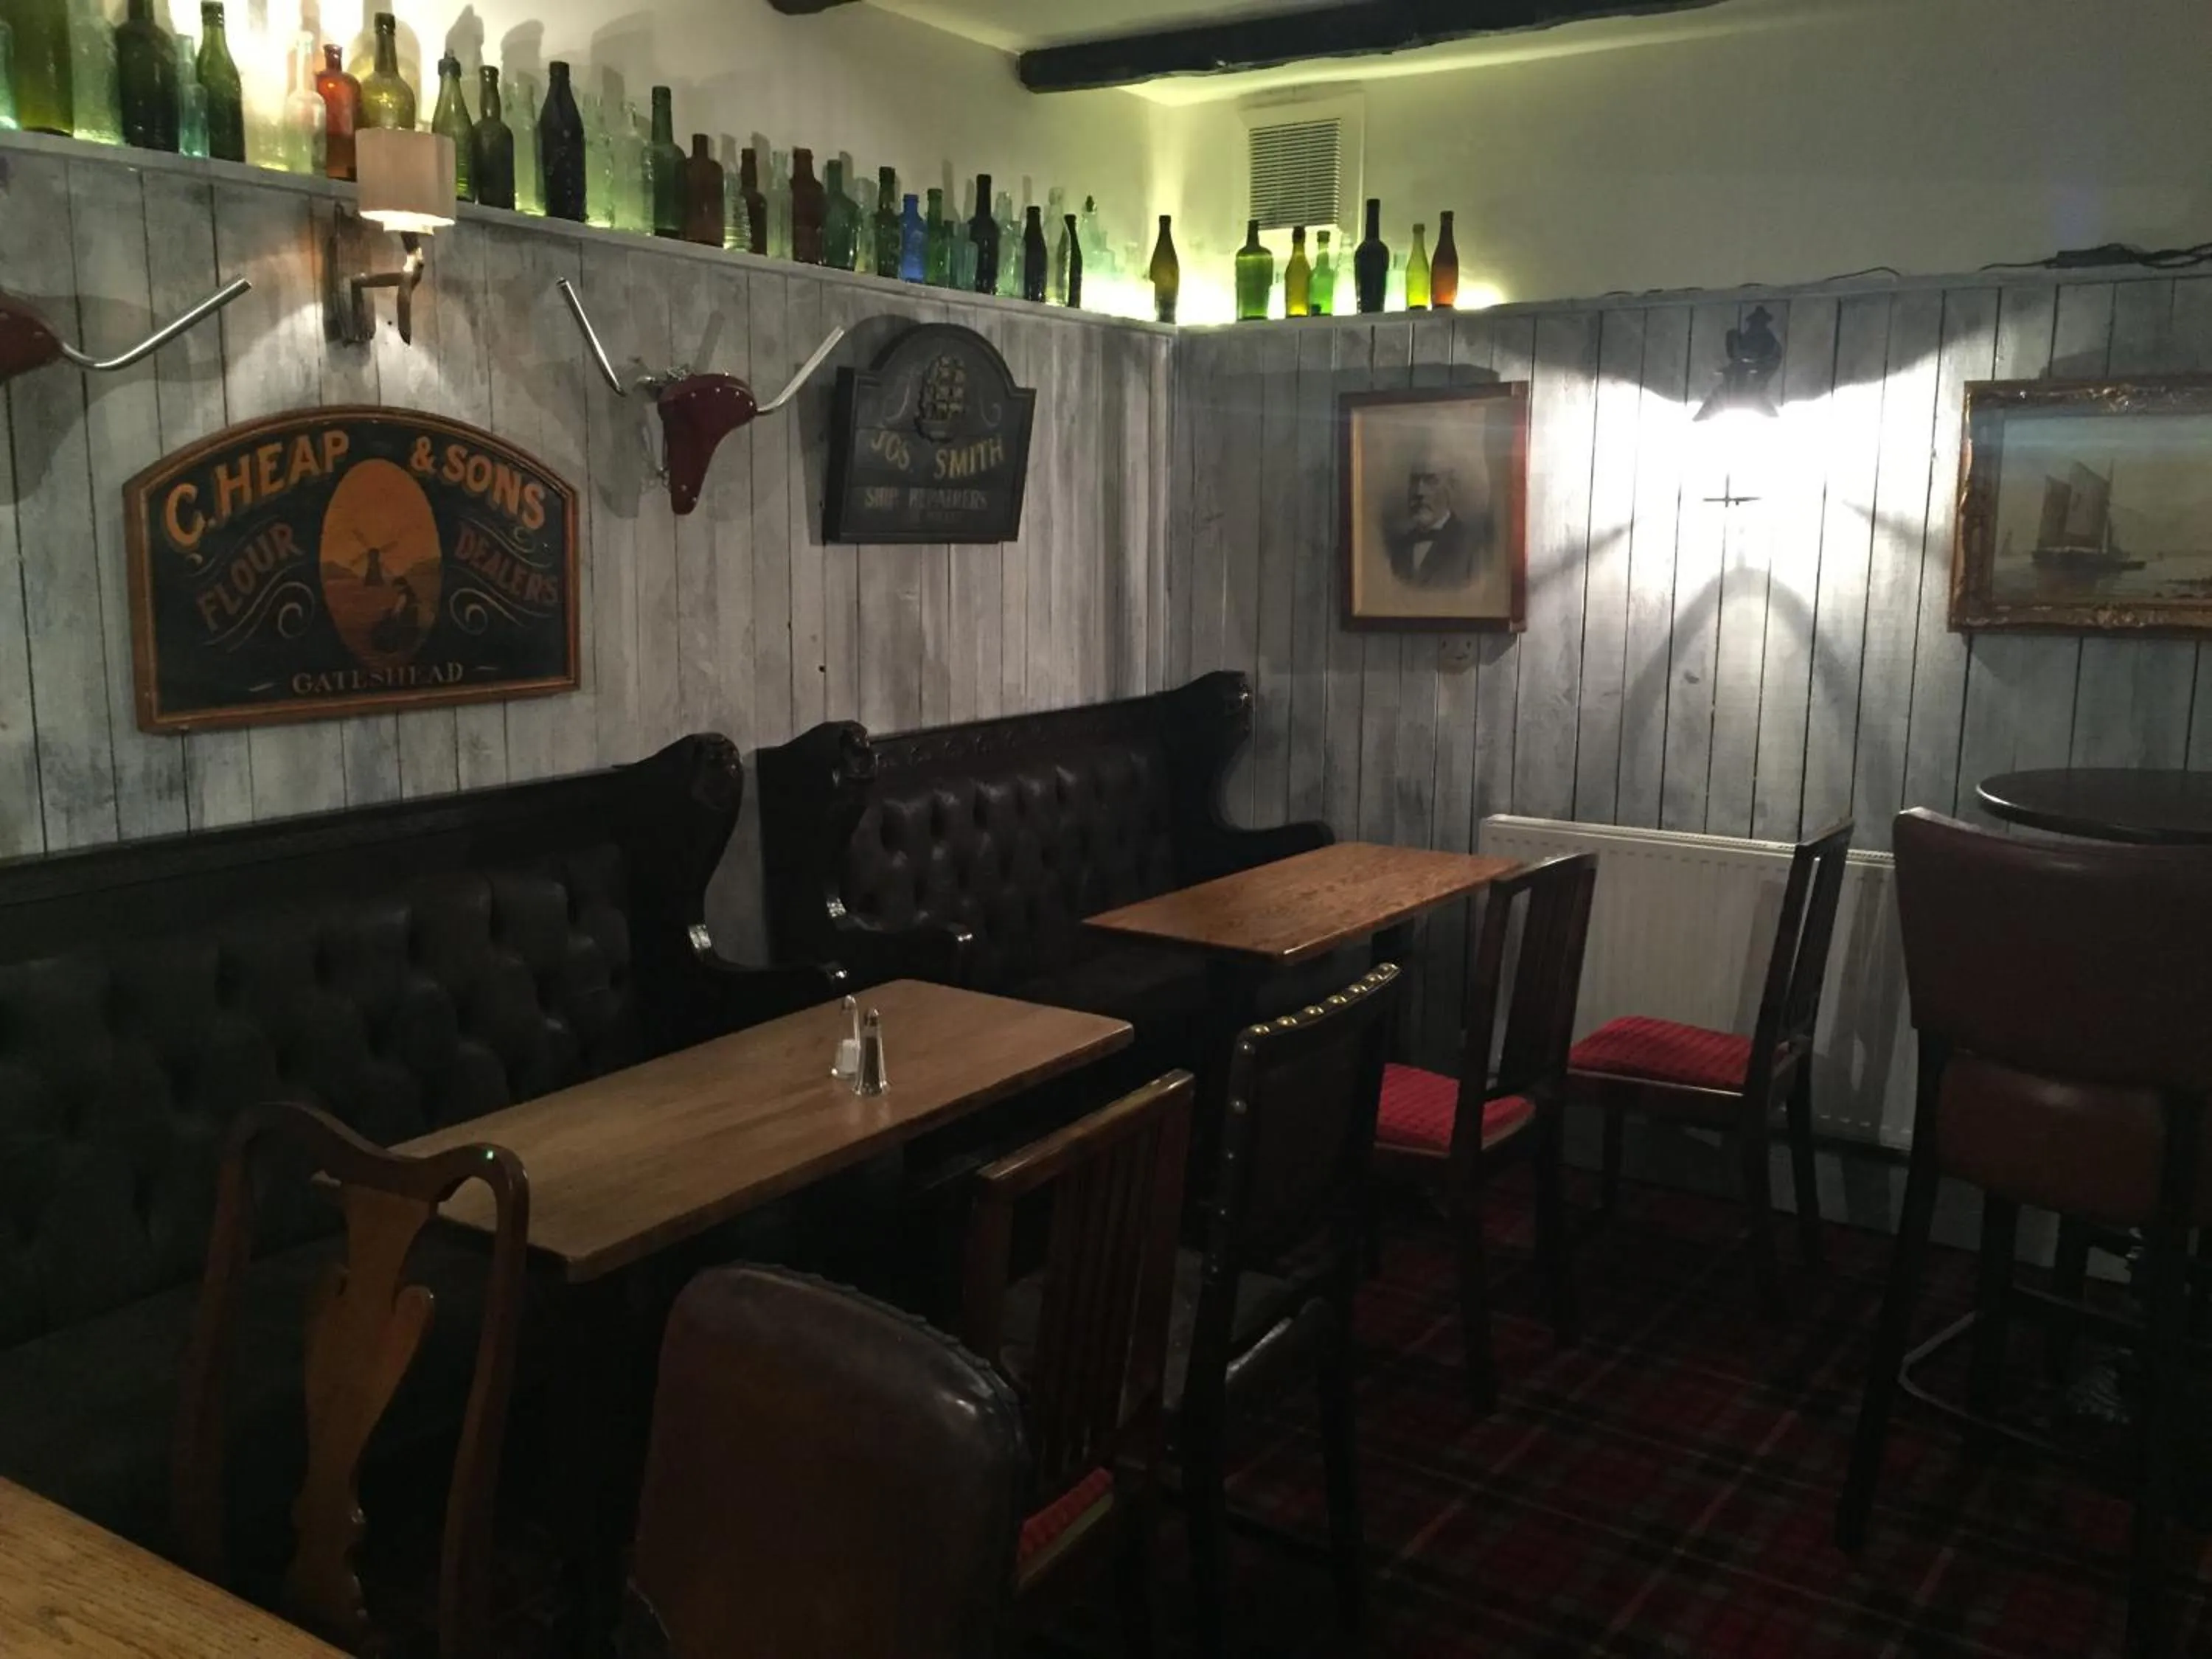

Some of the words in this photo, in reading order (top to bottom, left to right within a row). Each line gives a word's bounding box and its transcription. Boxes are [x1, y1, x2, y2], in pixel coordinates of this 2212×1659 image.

[410, 436, 437, 473] &
[442, 444, 546, 530] SONS
[933, 436, 1004, 479] SMITH
[196, 522, 305, 634] FLOUR
[454, 526, 562, 605] DEALERS
[292, 661, 465, 696] GATESHEAD
